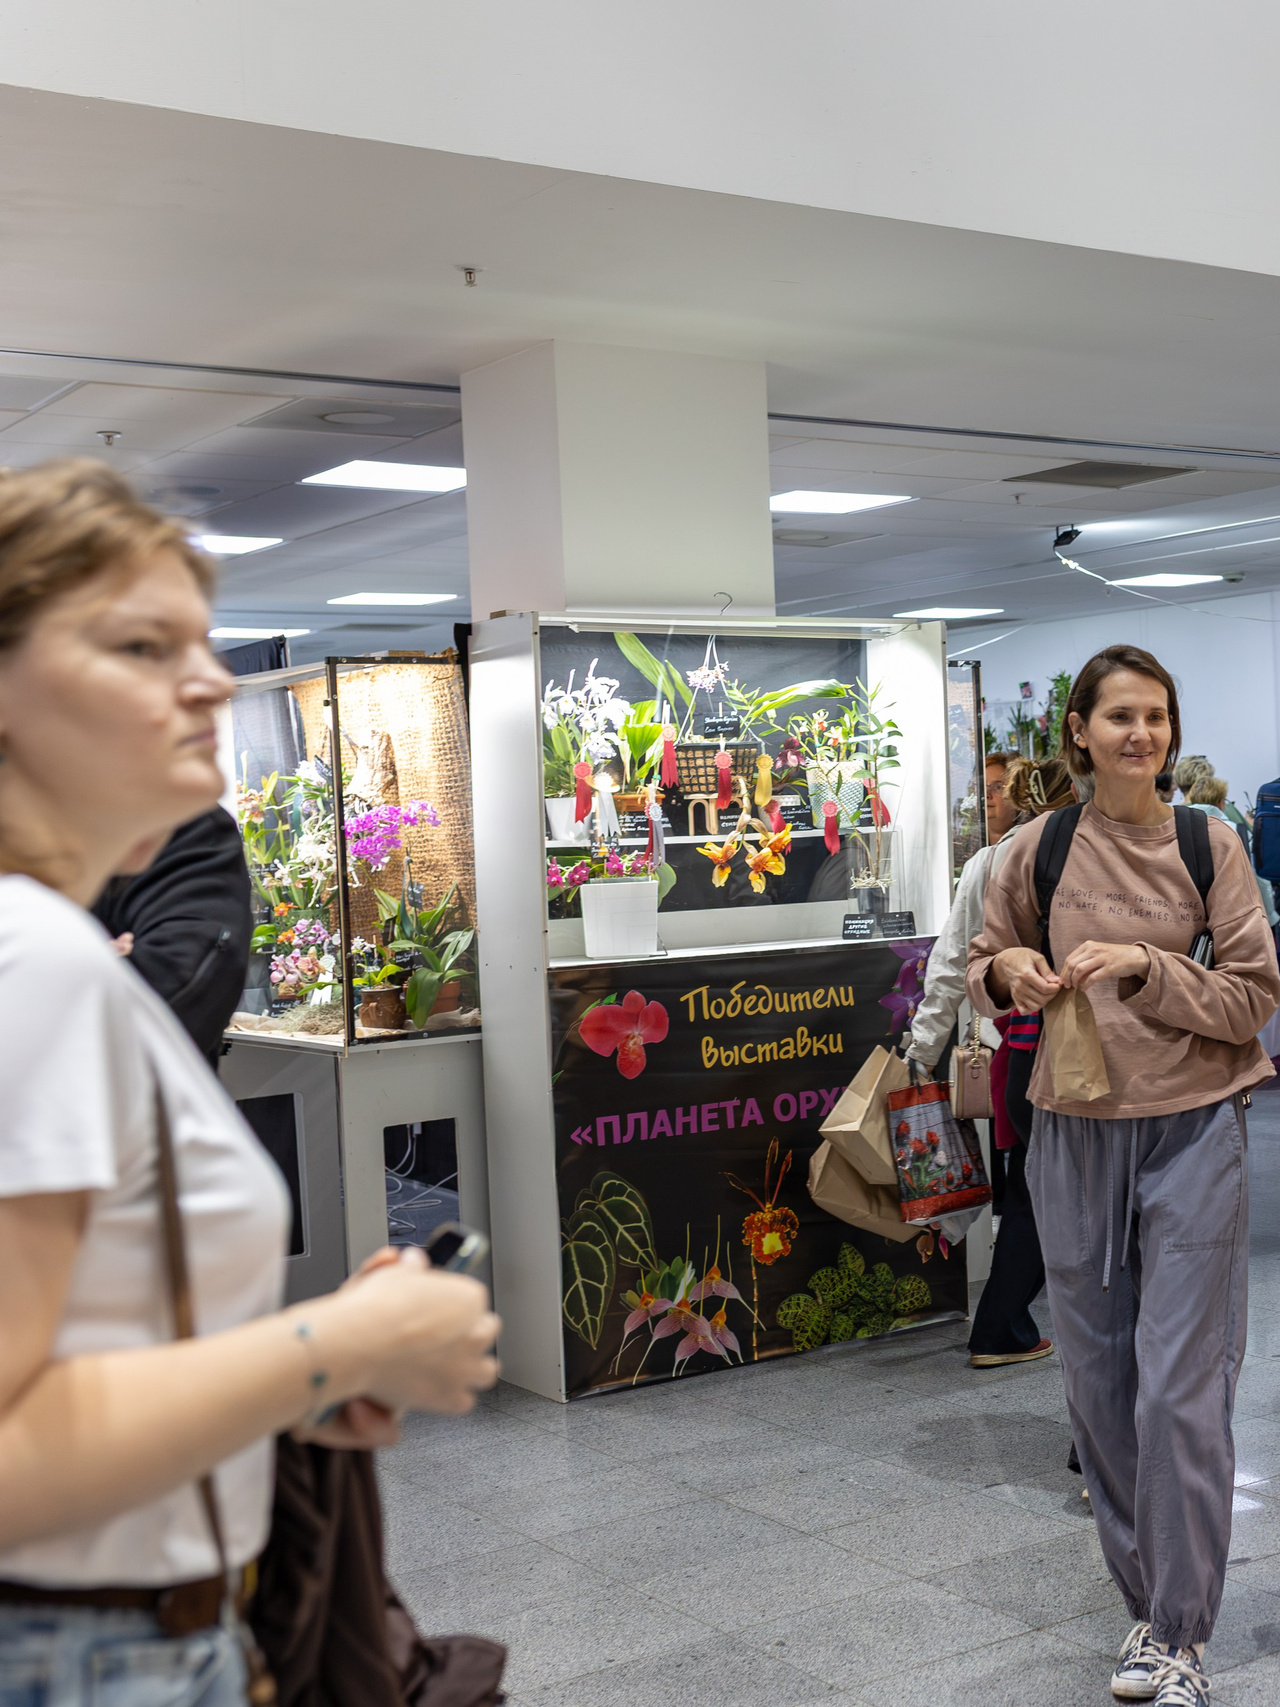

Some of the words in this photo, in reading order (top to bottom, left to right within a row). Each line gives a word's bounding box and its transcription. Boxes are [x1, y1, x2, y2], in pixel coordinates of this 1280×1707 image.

[1058, 901, 1071, 909] NO
[1076, 902, 1103, 913] HATE,
[1109, 906, 1123, 916] NO
[1128, 908, 1172, 922] ENEMIES,
[1180, 913, 1191, 922] NO
[1071, 888, 1098, 900] LOVE,
[1106, 893, 1127, 904] MORE
[1134, 894, 1171, 909] FRIENDS,
[1178, 901, 1199, 910] MORE
[679, 980, 855, 1022] Победители
[701, 1026, 844, 1069] выставки
[569, 1097, 765, 1147] «ПЛАНЕТА
[773, 1086, 848, 1122] ОРХ
